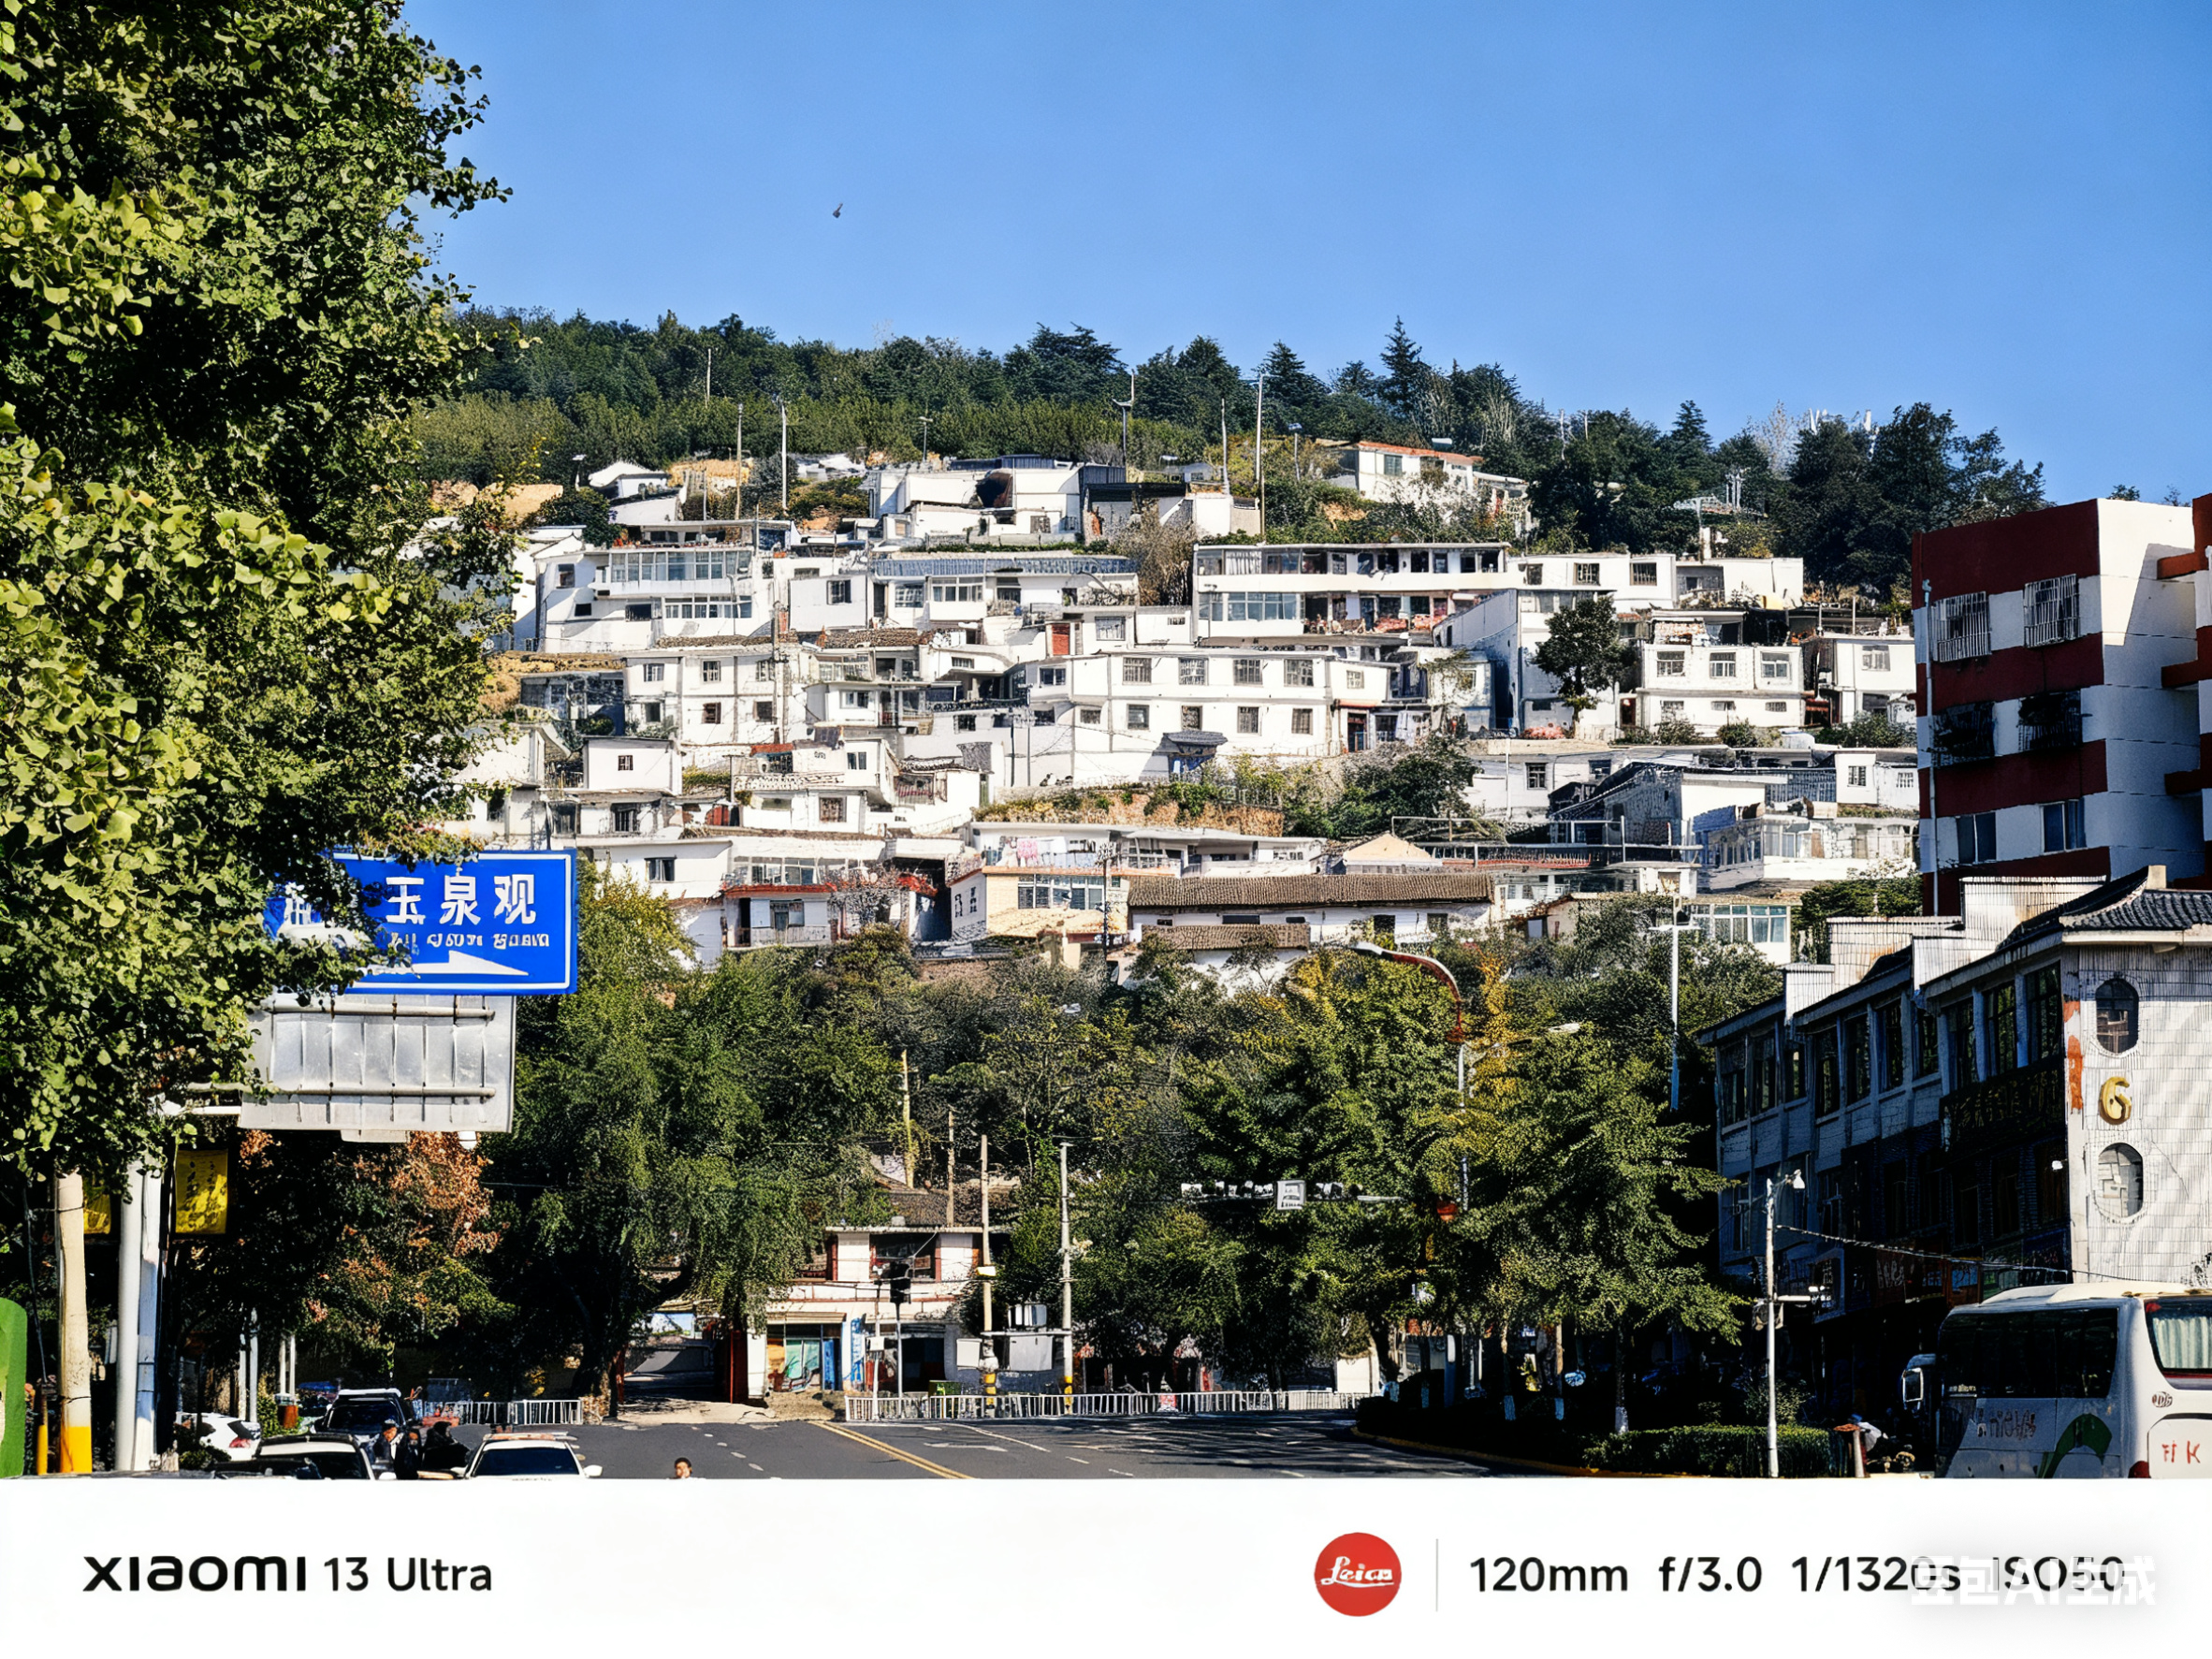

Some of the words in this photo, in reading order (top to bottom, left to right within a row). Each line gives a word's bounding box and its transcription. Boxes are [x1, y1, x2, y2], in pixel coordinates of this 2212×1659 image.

[386, 870, 537, 925] 玉泉观
[2099, 1076, 2132, 1126] 6
